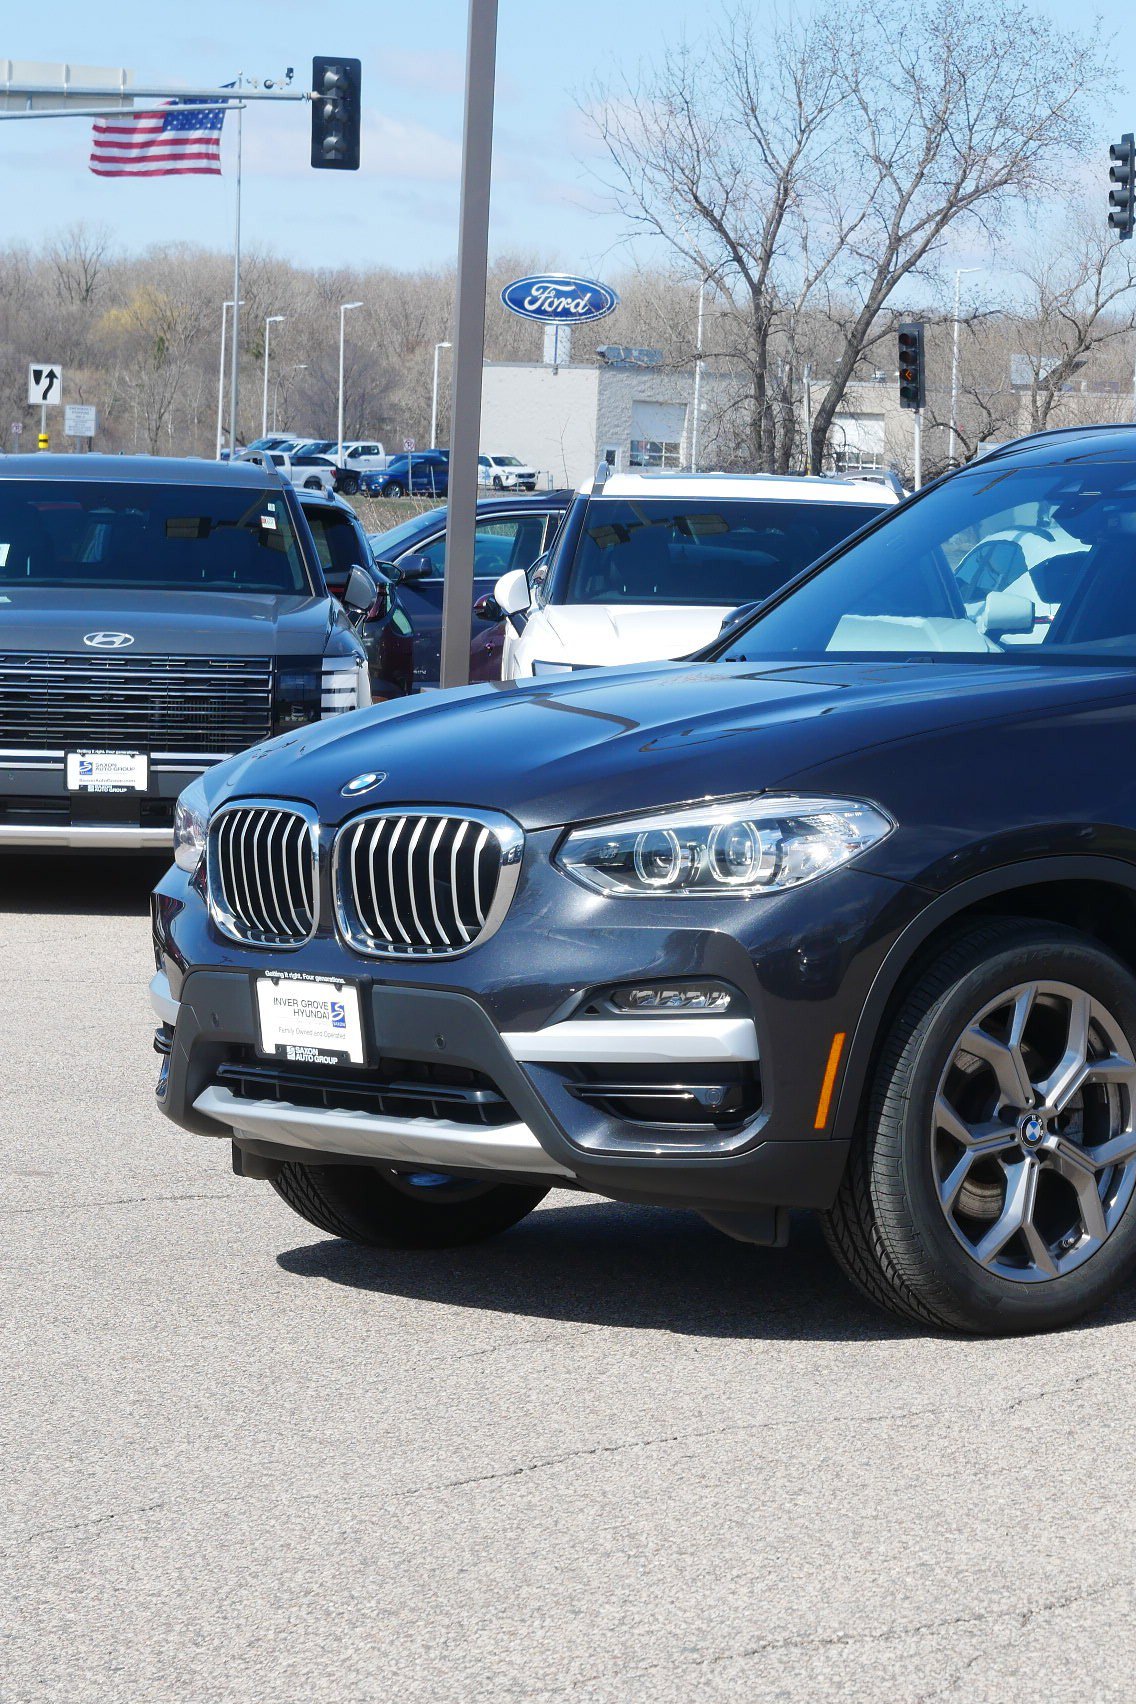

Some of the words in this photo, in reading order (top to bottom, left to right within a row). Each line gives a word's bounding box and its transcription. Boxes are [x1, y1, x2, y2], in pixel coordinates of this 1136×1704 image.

[524, 283, 592, 313] Ford
[265, 970, 284, 979] Getting
[303, 973, 315, 981] Four
[315, 975, 346, 984] generations.
[273, 997, 299, 1007] INVER
[300, 1000, 329, 1011] GROVE
[293, 1008, 330, 1020] HYUNDAI
[279, 1026, 295, 1035] Family
[295, 1027, 313, 1036] Owned
[323, 1030, 346, 1040] Operated
[295, 1046, 319, 1056] SAXON
[295, 1053, 314, 1062] AUTO
[314, 1055, 338, 1065] GROUP
